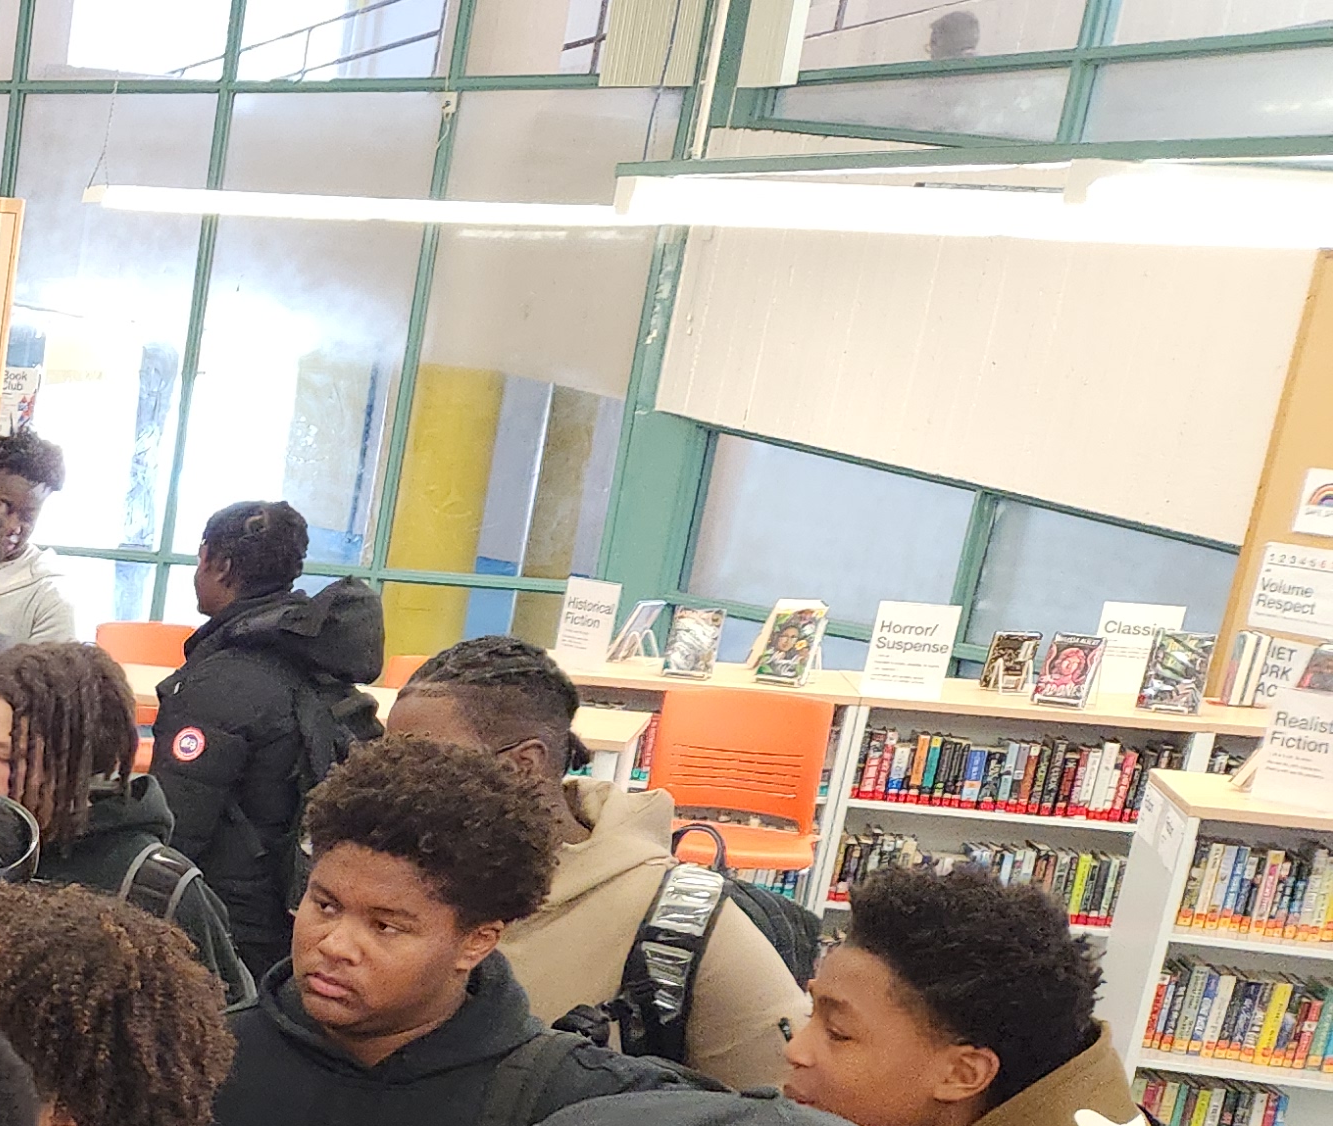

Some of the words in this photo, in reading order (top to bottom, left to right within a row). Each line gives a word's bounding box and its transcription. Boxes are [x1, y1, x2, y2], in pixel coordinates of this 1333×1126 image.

[1261, 577, 1314, 598] Volume
[567, 596, 615, 615] Historical
[1255, 593, 1316, 615] Respect
[564, 611, 601, 629] Fiction
[879, 620, 940, 637] Horror/
[1104, 620, 1175, 639] Classi
[875, 636, 949, 654] Suspense
[1267, 645, 1297, 662] IET
[1270, 731, 1330, 754] Fiction
